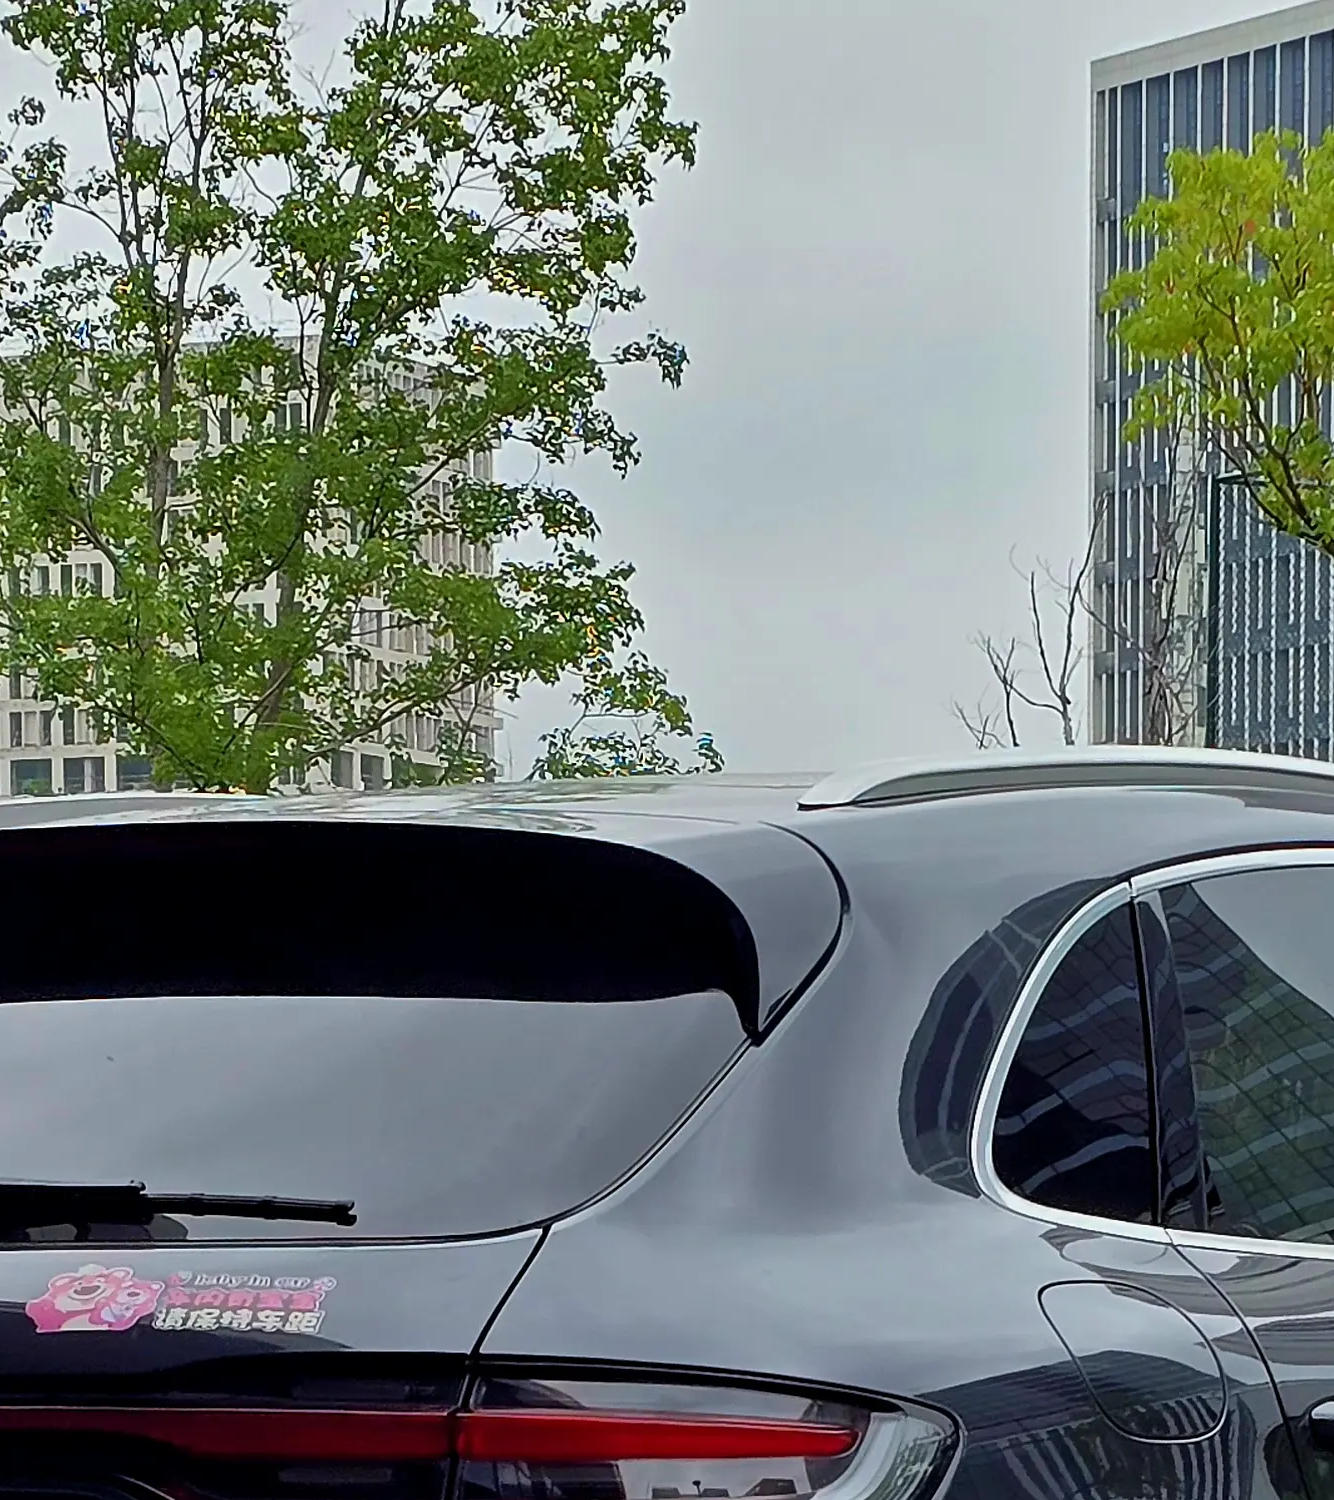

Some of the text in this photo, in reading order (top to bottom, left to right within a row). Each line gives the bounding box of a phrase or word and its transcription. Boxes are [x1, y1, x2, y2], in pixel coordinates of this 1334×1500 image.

[155, 1307, 321, 1332] 请保持车距
